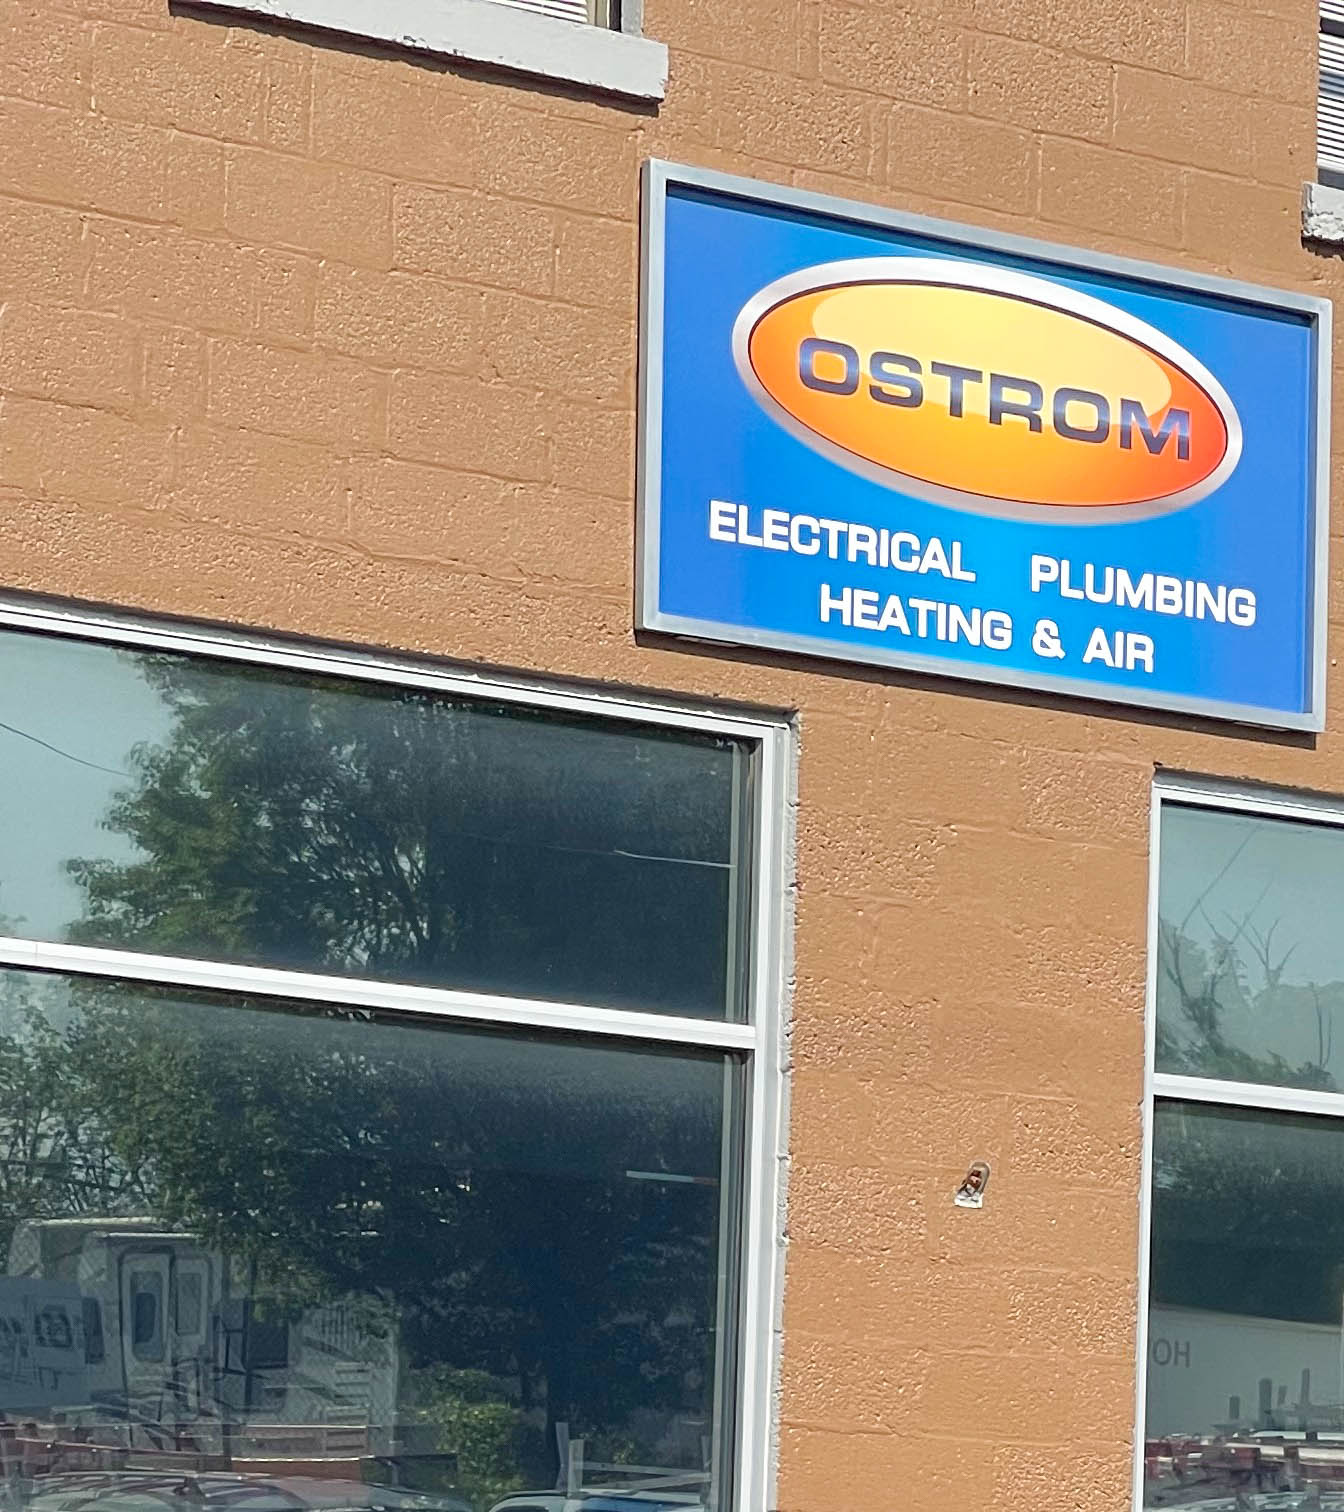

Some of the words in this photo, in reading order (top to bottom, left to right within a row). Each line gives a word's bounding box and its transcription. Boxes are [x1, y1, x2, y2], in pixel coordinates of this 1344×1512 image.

[799, 337, 1190, 461] OSTROM
[708, 499, 977, 583] ELECTRICAL
[1031, 554, 1257, 628] PLUMBING
[820, 583, 1013, 652] HEATING
[1031, 619, 1066, 661] &
[1081, 627, 1155, 674] AIR
